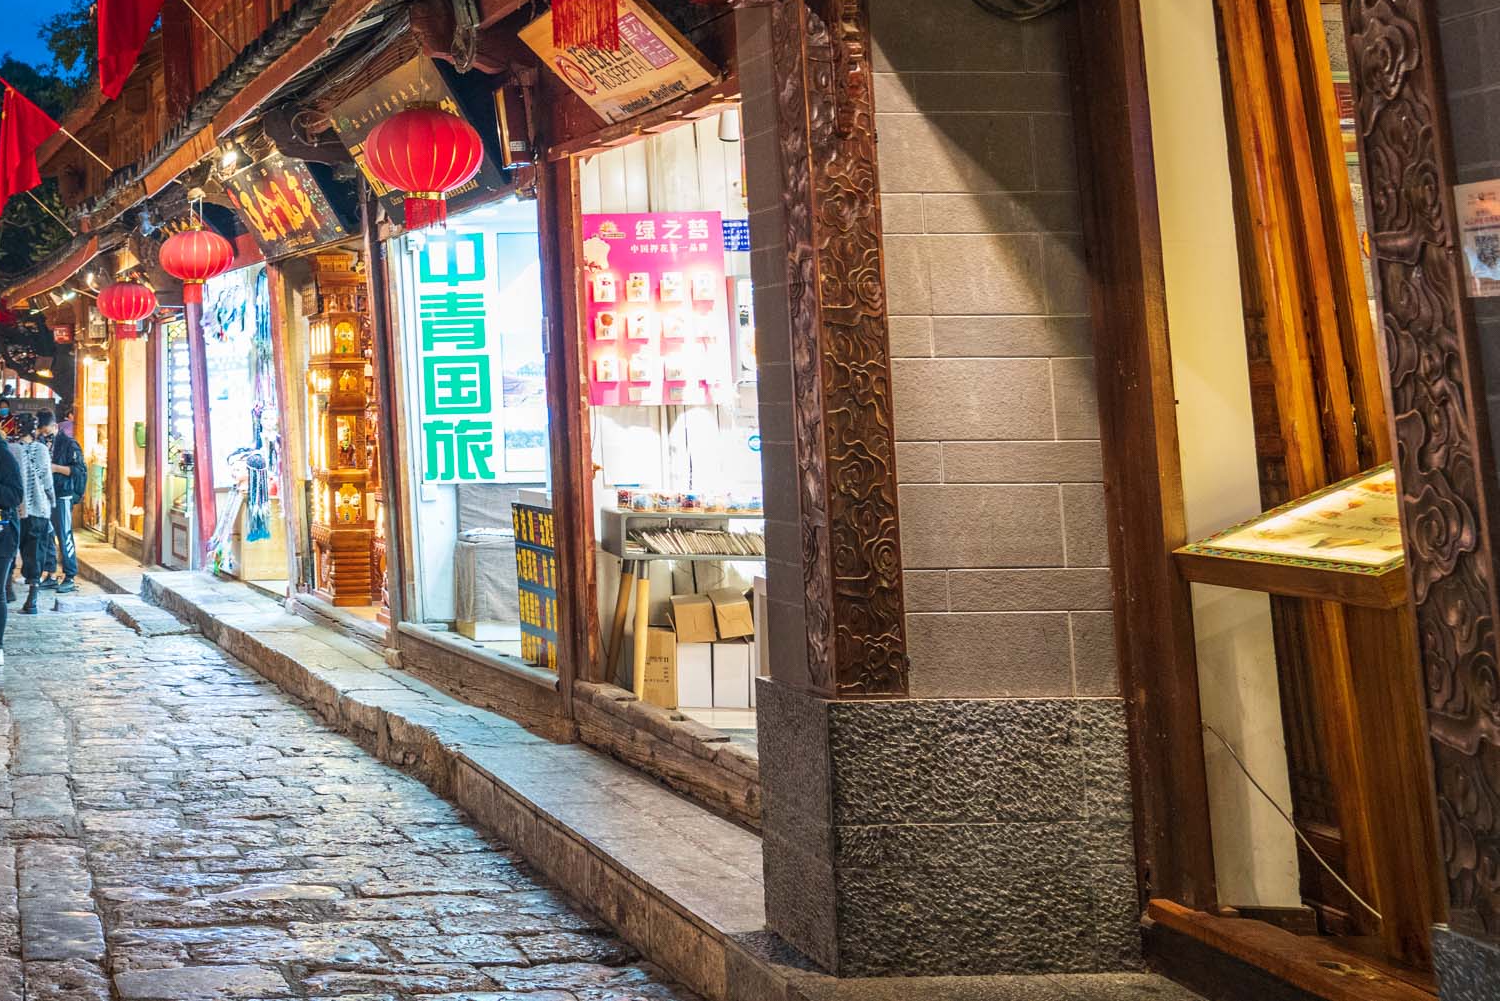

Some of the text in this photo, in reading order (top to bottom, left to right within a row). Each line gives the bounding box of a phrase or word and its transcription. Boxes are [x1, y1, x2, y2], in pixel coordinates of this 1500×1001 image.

[635, 218, 709, 241] 绿之梦
[419, 230, 496, 481] 中青国旅
